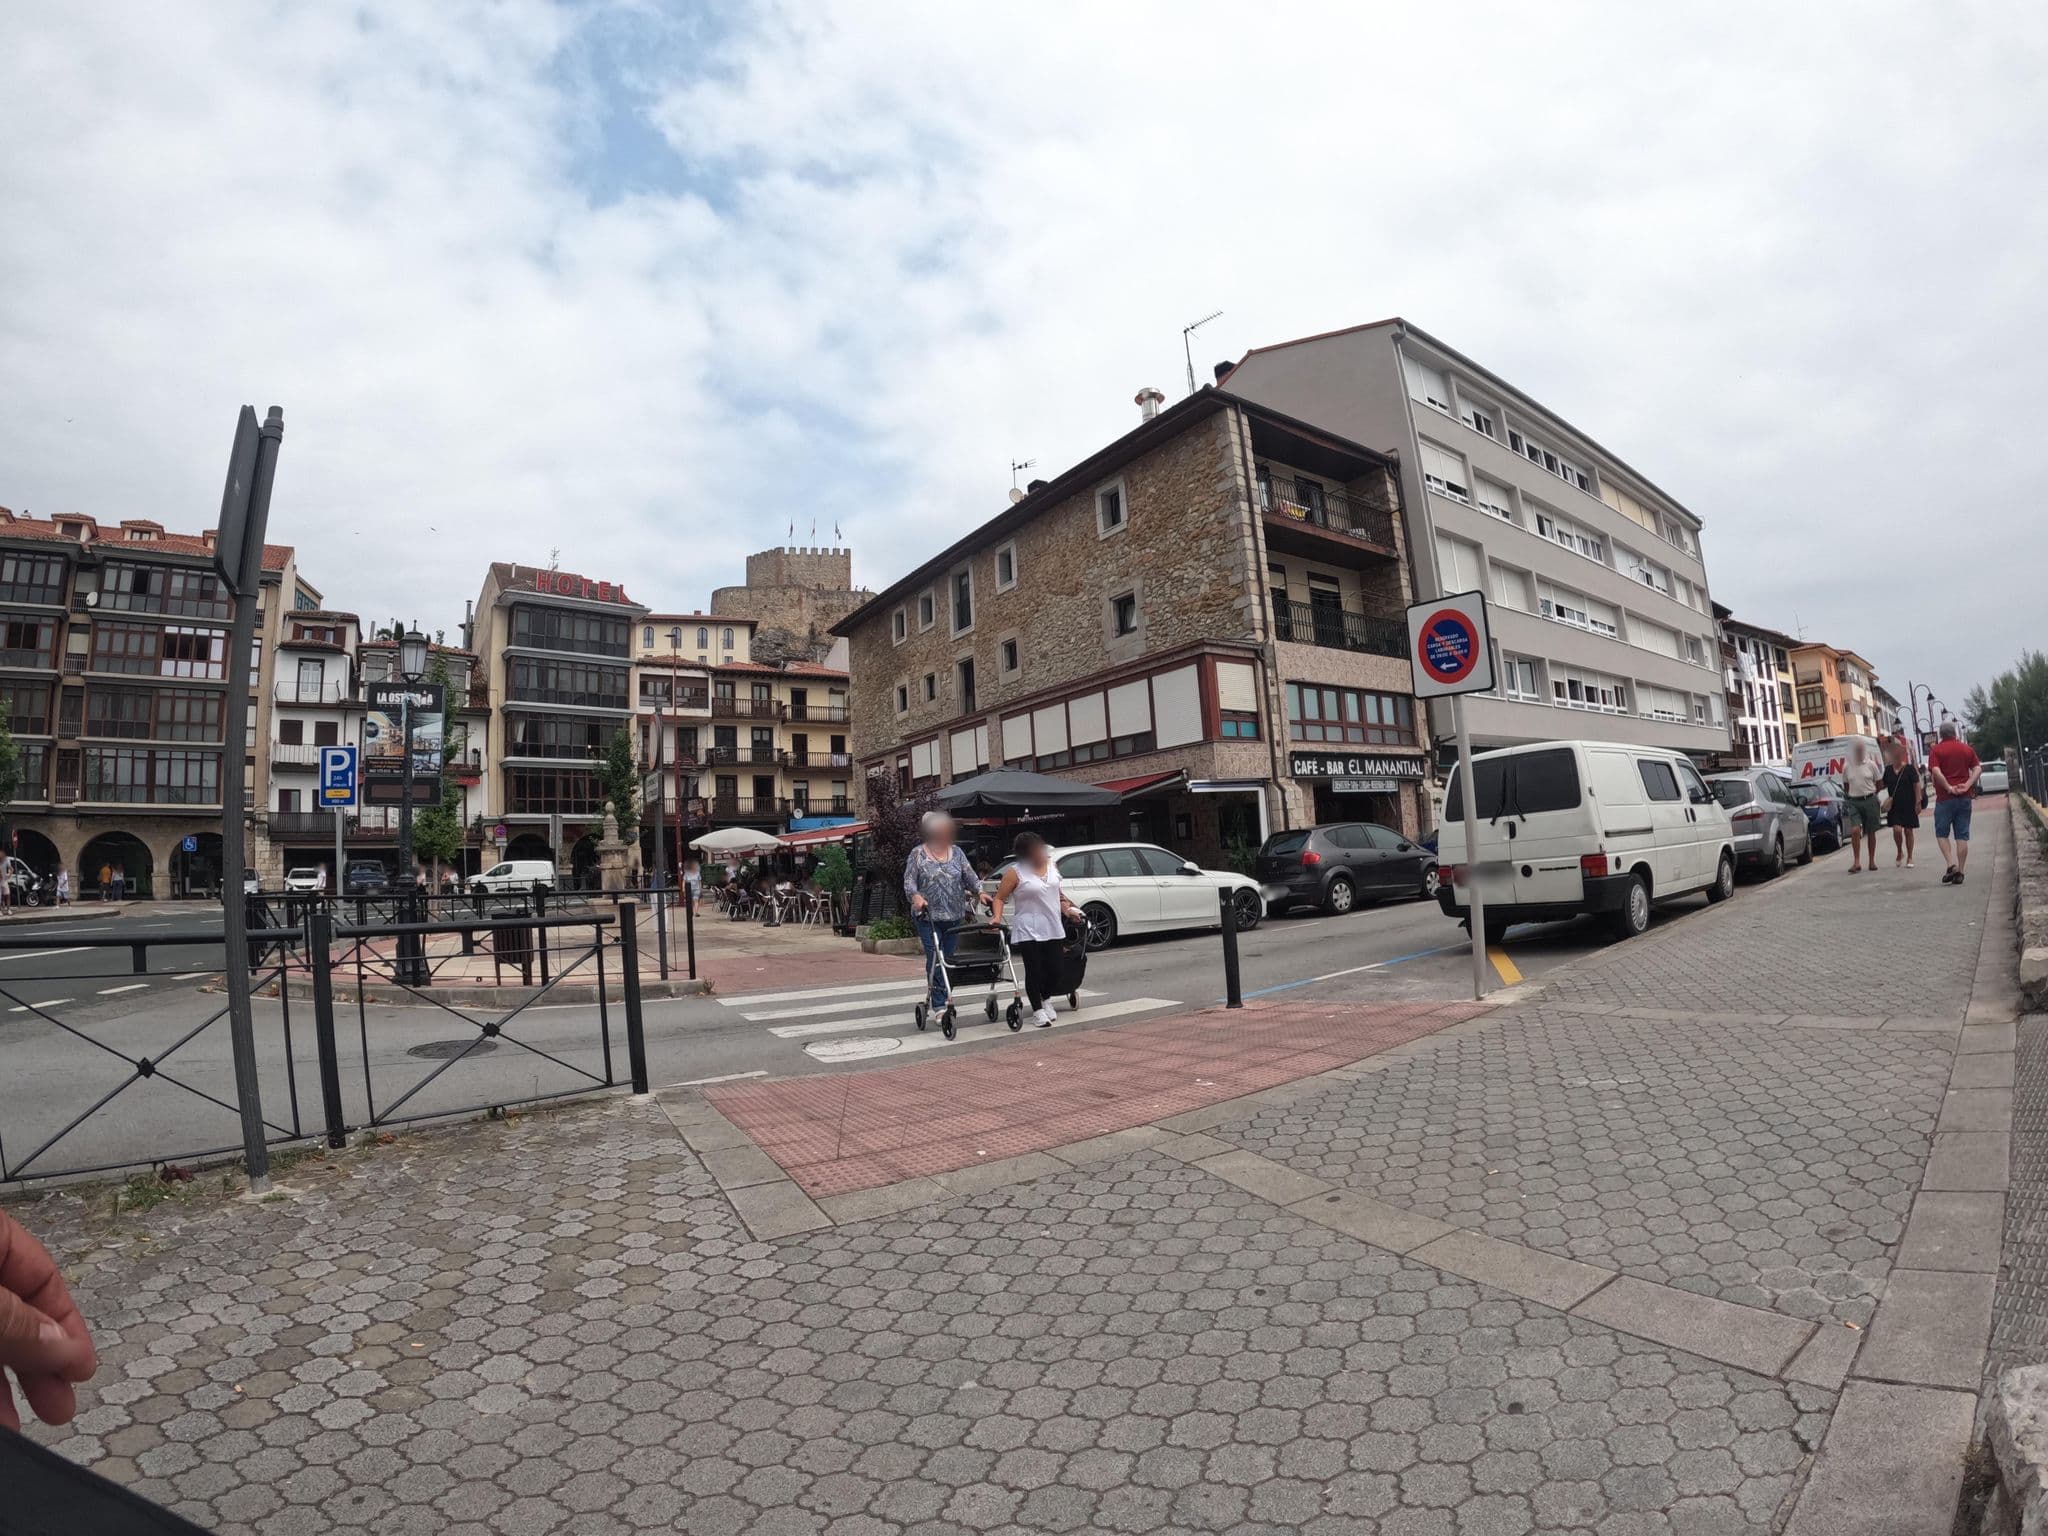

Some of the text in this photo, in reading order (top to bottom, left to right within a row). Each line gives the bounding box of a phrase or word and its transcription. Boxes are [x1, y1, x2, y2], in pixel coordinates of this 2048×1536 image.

[536, 571, 630, 604] HOTEL
[376, 692, 387, 704] LA
[325, 750, 351, 787] P
[1294, 758, 1318, 775] CAFÉ
[1326, 760, 1345, 775] BAR
[1348, 759, 1363, 775] EL
[1365, 759, 1424, 776] MANANTIAL
